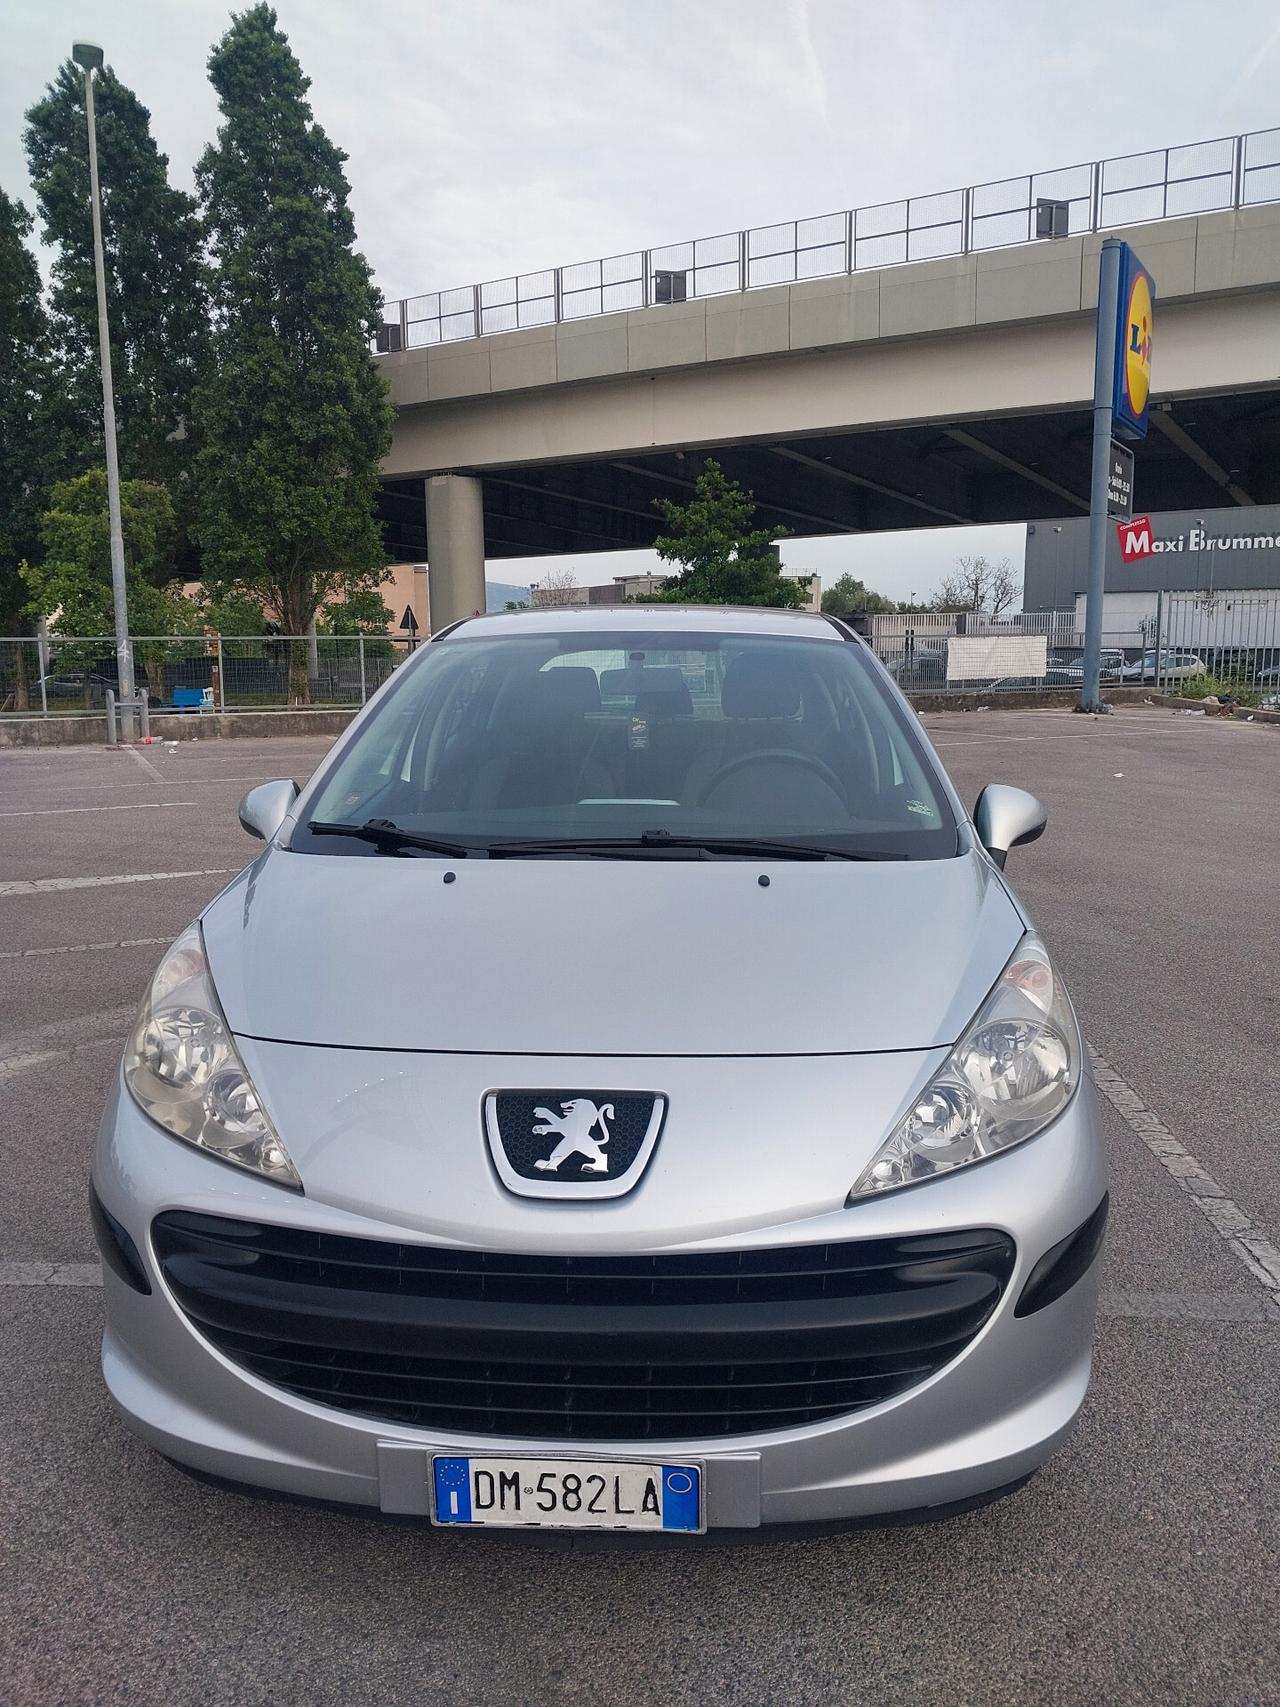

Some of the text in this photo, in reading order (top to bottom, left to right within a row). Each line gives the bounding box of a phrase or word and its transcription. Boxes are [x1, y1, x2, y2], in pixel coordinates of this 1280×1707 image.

[1125, 530, 1184, 554] Maxi
[450, 1470, 662, 1516] I DM 582LA
